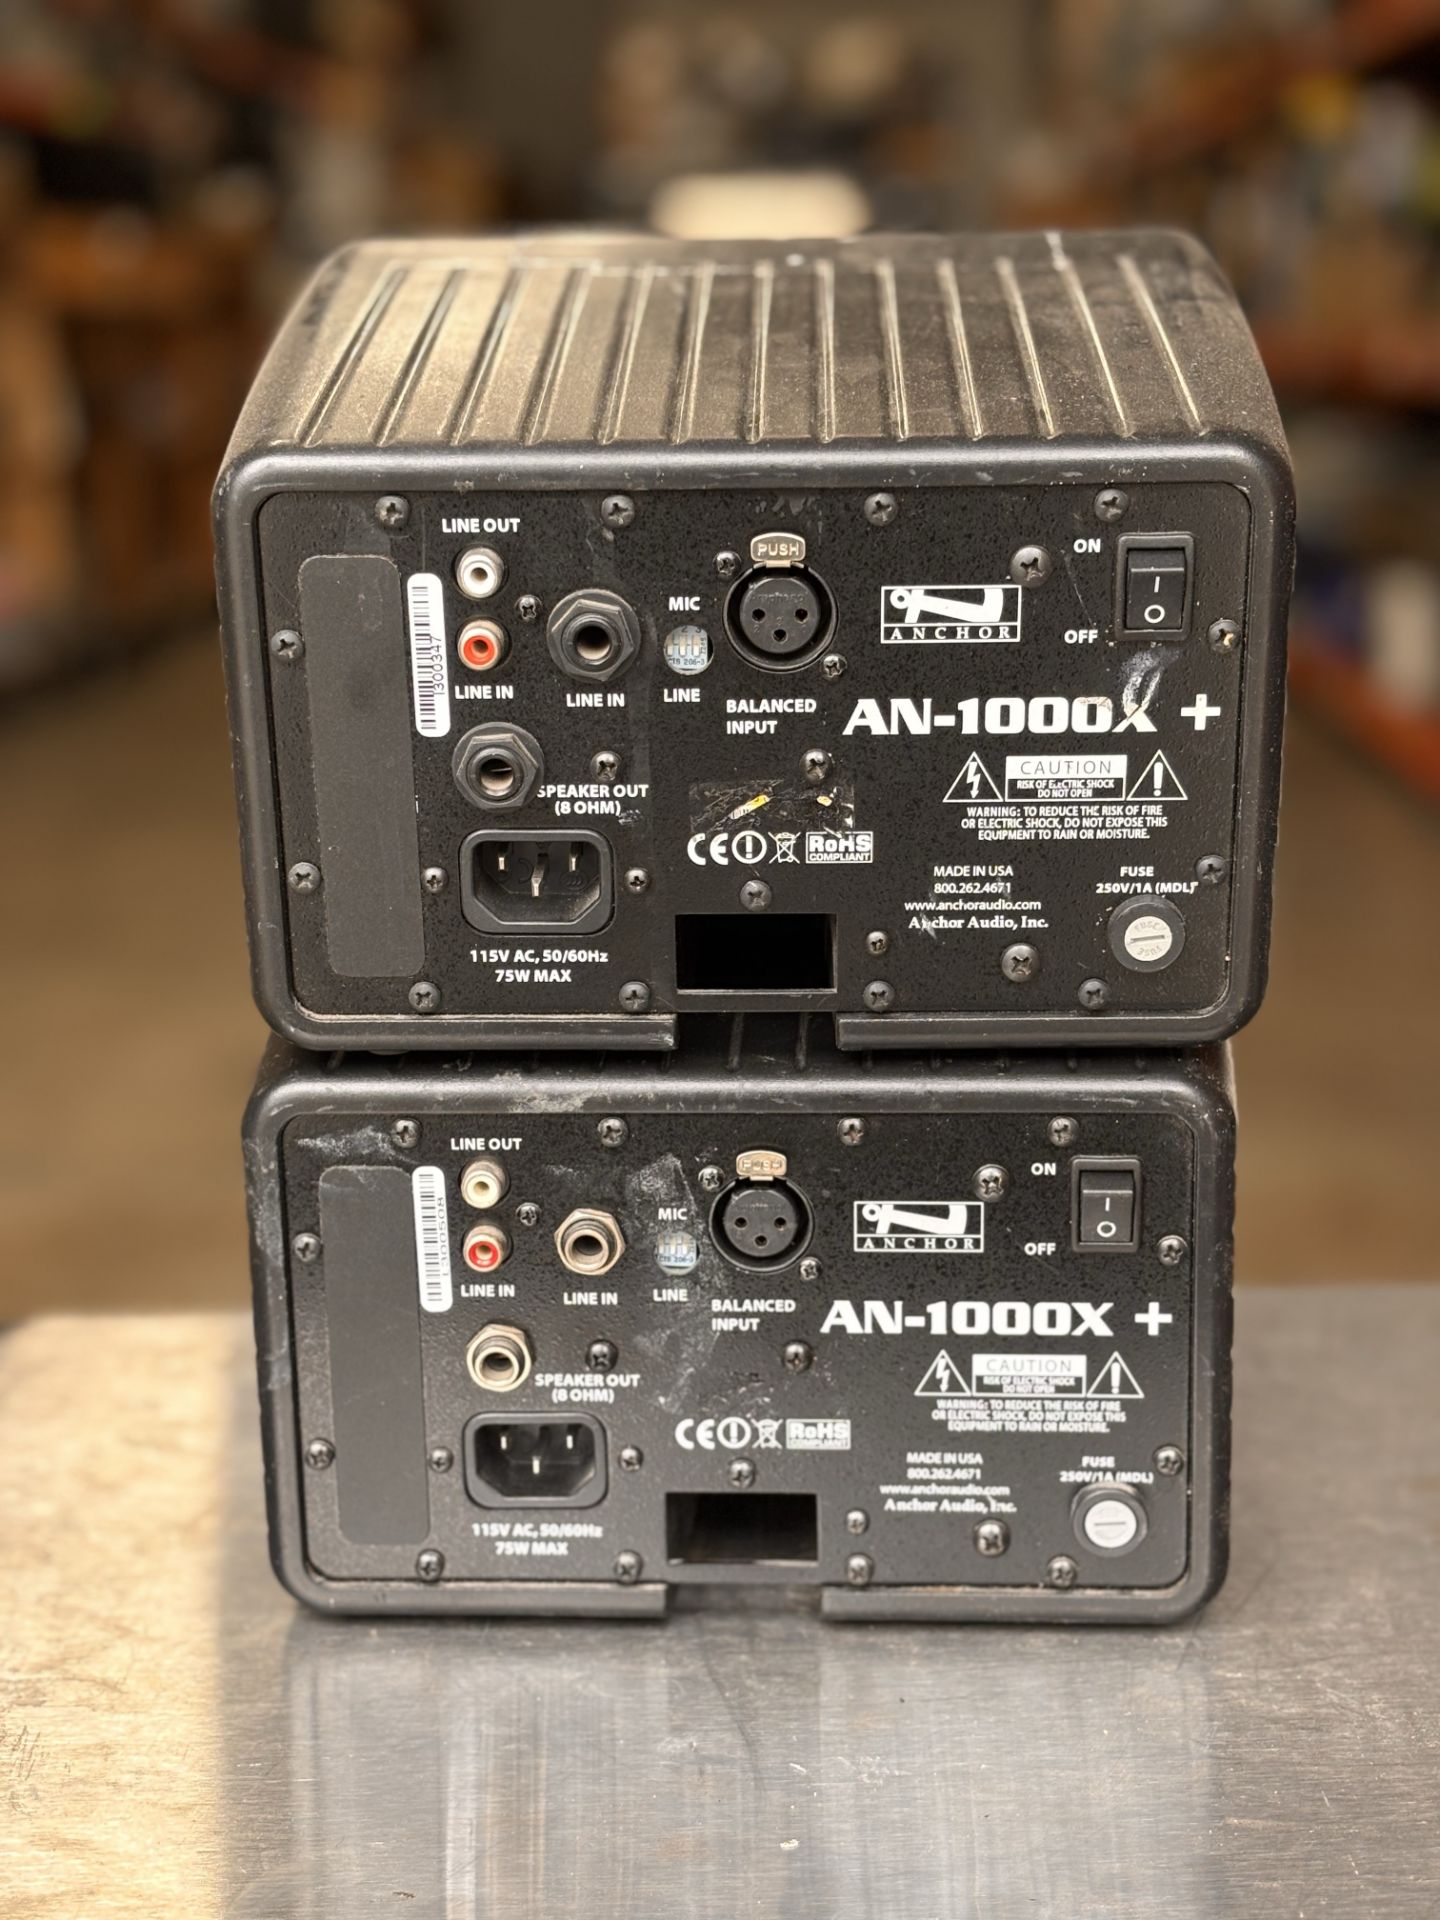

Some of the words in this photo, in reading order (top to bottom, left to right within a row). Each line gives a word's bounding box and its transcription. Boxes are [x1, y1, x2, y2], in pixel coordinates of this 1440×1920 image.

[442, 518, 480, 533] LINE
[484, 518, 520, 533] OUT
[757, 543, 800, 556] PUSH
[1074, 538, 1100, 554] ON
[668, 597, 701, 612] MIC
[890, 626, 1011, 640] ANCHOR
[1064, 630, 1098, 644] OFF
[430, 635, 446, 696] 1300347
[455, 686, 492, 699] LINE
[496, 686, 514, 699] IN
[663, 689, 701, 703] LINE
[566, 694, 603, 707] LINE
[606, 694, 624, 707] IN
[726, 699, 817, 714] BALANCED
[842, 698, 1158, 736] AN-1000X
[726, 721, 778, 734] INPUT
[1020, 760, 1112, 775] CAUTION
[537, 784, 610, 798] SPEAKER
[613, 784, 649, 798] OUT
[1017, 780, 1034, 789] RISK
[1036, 780, 1047, 789] OF
[1086, 780, 1114, 788] SHOCK
[1038, 789, 1050, 797] DO
[1052, 789, 1068, 797] NOT
[1070, 789, 1092, 797] OPEN
[554, 801, 570, 816] (8
[573, 801, 621, 816] OHM)
[967, 807, 1020, 817] WARNING:
[1024, 806, 1037, 817] TO
[1039, 806, 1078, 816] REDUCE
[1080, 806, 1100, 816] THE
[1102, 806, 1123, 816] RISK
[1126, 806, 1139, 816] OF
[1142, 806, 1162, 816] FIRE
[961, 819, 976, 829] OR
[978, 818, 1023, 828] ELECTRIC
[1025, 818, 1062, 828] SHOCK,
[1064, 818, 1079, 828] DO
[1081, 818, 1103, 828] NOT
[1106, 817, 1144, 827] EXPOSE
[1146, 817, 1168, 827] THIS
[978, 830, 1036, 840] EQUIPMENT
[1038, 829, 1051, 840] TO
[1053, 829, 1077, 840] RAIN
[1079, 829, 1094, 839] OR
[1096, 829, 1150, 839] MOISTURE.
[687, 832, 729, 866] CE
[809, 835, 872, 852] RoHS
[809, 852, 870, 862] COMPLIANT
[934, 866, 970, 876] MADE
[973, 866, 986, 876] IN
[989, 866, 1013, 876] USA
[1120, 866, 1154, 877] FUSE
[934, 882, 1011, 893] 800.262.4671
[1096, 882, 1152, 894] 250V/1A
[1155, 882, 1198, 894] (MDL)
[904, 900, 1042, 910] www.anchoraudio.com
[967, 916, 1018, 930] Audio,
[1021, 917, 1049, 929] Inc.
[470, 950, 510, 962] 115V
[513, 950, 539, 964] AC,
[542, 950, 608, 963] 50/60Hz
[495, 970, 531, 983] 75W
[534, 970, 572, 983] MAX
[450, 1138, 485, 1150] LINE
[488, 1138, 522, 1150] OUT
[1032, 1163, 1056, 1176] ON
[658, 1208, 688, 1220] MIC
[863, 1238, 974, 1250] ANCHOR
[1024, 1243, 1056, 1256] OFF
[461, 1285, 496, 1297] LINE
[499, 1285, 515, 1297] IN
[653, 1288, 688, 1302] LINE
[563, 1292, 598, 1305] LINE
[601, 1292, 618, 1305] IN
[711, 1300, 796, 1312] BALANCED
[712, 1318, 760, 1331] INPUT
[820, 1300, 1114, 1336] AN-1000X
[986, 1358, 1072, 1373] CAUTION
[535, 1374, 603, 1387] SPEAKER
[606, 1374, 641, 1387] OUT
[552, 1389, 568, 1404] (8
[570, 1389, 615, 1404] OHM)
[674, 1418, 716, 1450] CE
[790, 1422, 848, 1439] RoHS
[907, 1453, 942, 1464] MADE
[944, 1453, 956, 1464] IN
[958, 1453, 983, 1464] USA
[1082, 1457, 1115, 1468] FUSE
[884, 1499, 937, 1511] Anchor
[940, 1500, 988, 1514] Audio,
[990, 1500, 1017, 1512] Inc.
[472, 1524, 511, 1537] 115V
[512, 1524, 538, 1538] AC,
[540, 1524, 603, 1538] 50/60Hz
[495, 1541, 530, 1555] 75W
[532, 1541, 568, 1555] MAX
